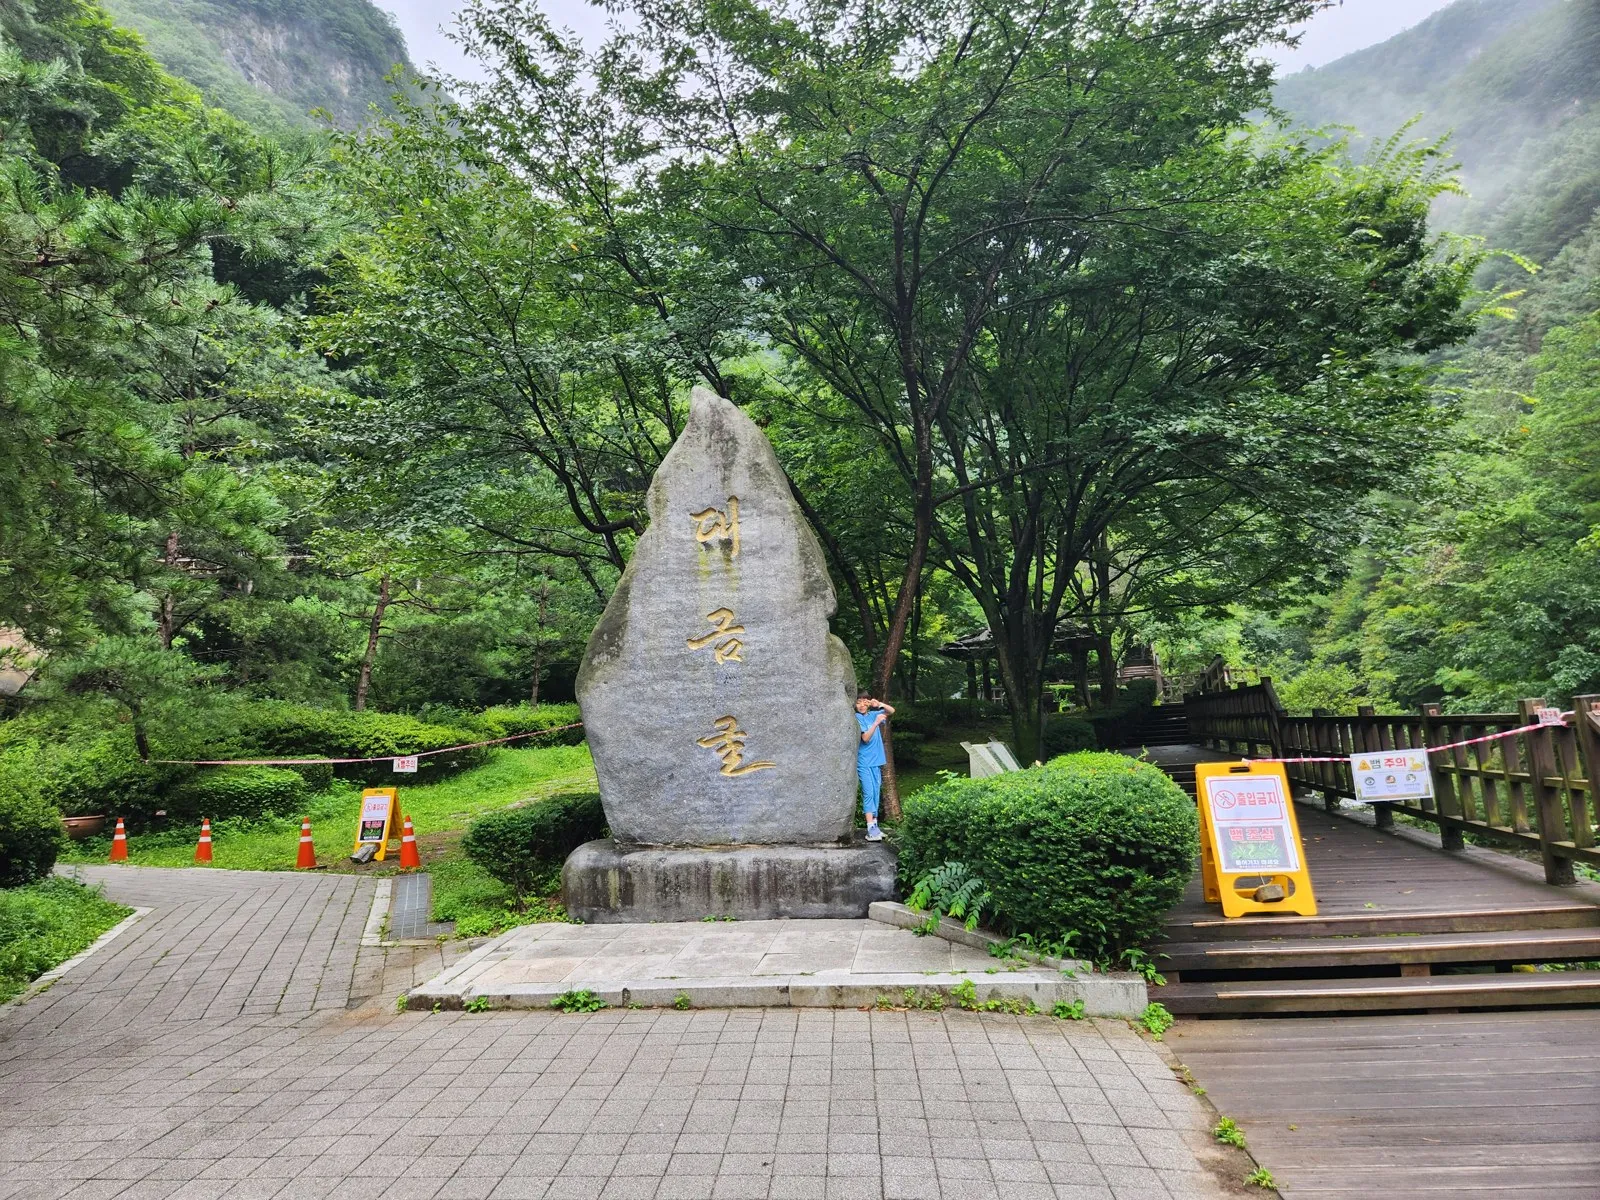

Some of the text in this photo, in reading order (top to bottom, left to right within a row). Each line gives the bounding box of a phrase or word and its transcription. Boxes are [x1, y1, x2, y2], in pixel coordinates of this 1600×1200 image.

[1369, 757, 1407, 769] 뱀 주의
[1236, 791, 1277, 806] 출입금지
[1229, 827, 1275, 840] 뱀 조심
